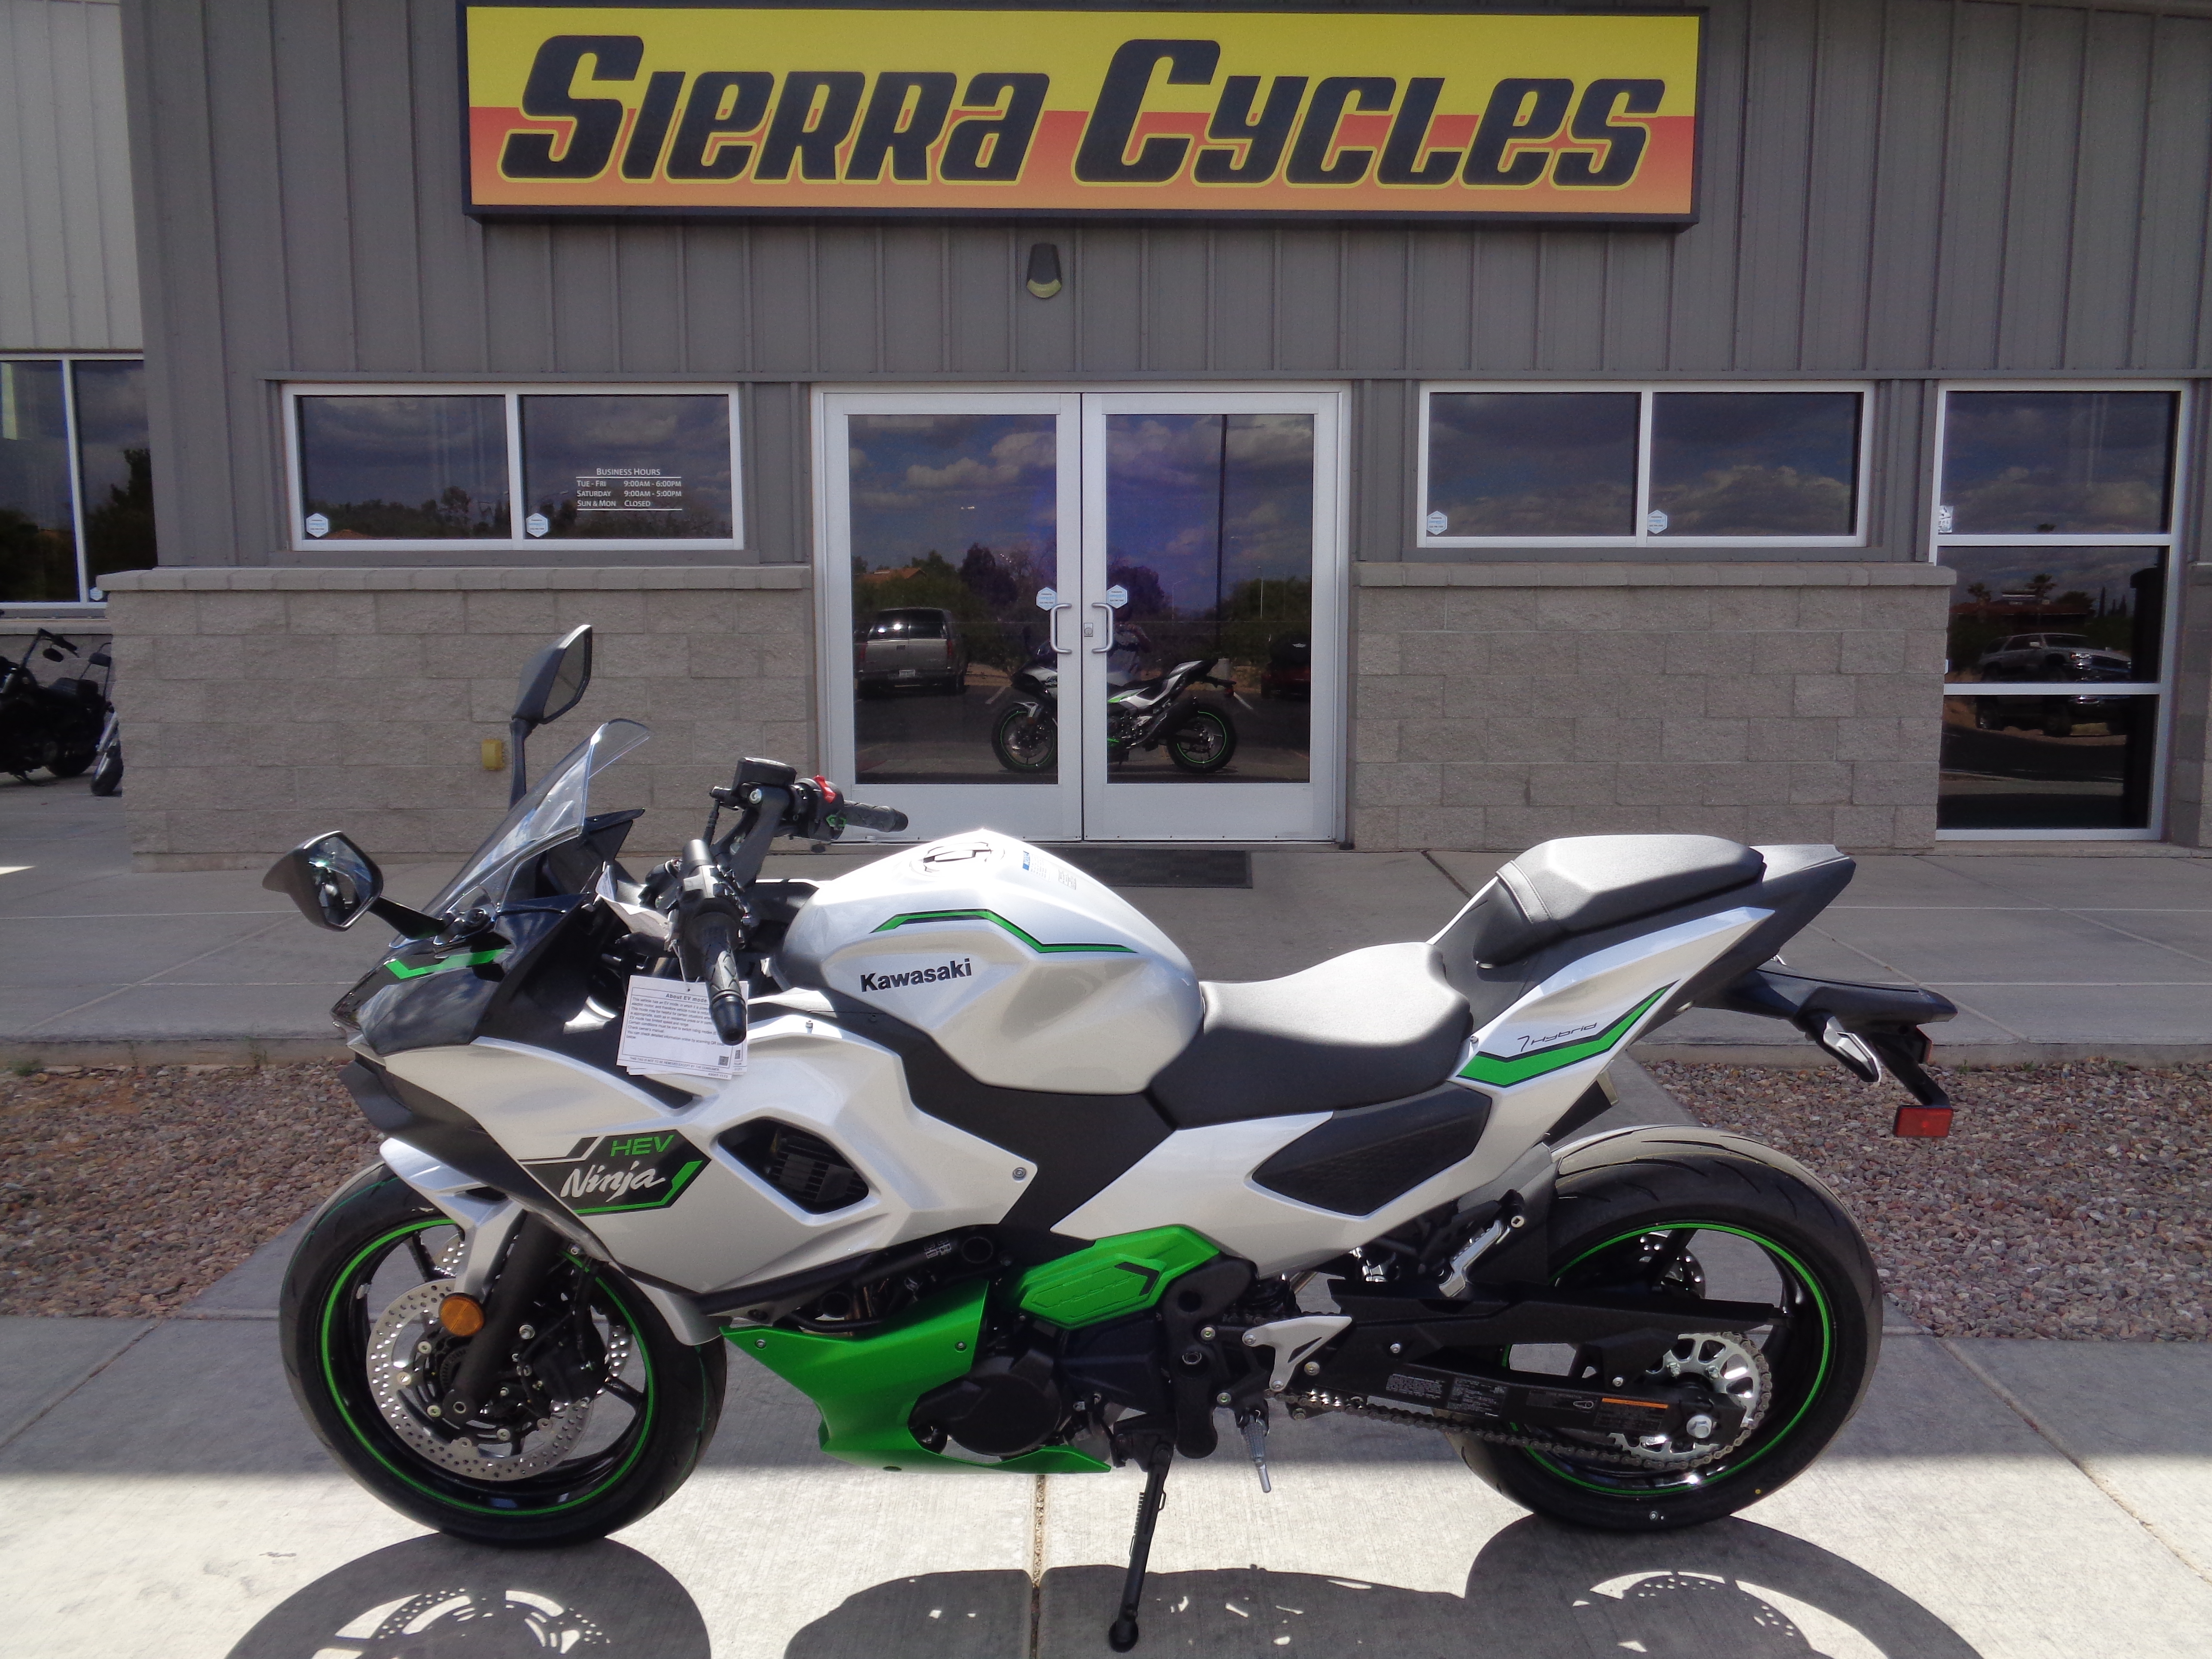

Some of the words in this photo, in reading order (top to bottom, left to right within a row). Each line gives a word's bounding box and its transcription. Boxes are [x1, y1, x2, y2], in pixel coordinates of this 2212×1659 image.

[860, 957, 972, 993] Kawasaki
[1517, 1035, 1530, 1052] 7
[1531, 1022, 1597, 1045] Hybrid
[610, 1135, 675, 1157] HEV
[560, 1160, 666, 1202] Ninja
